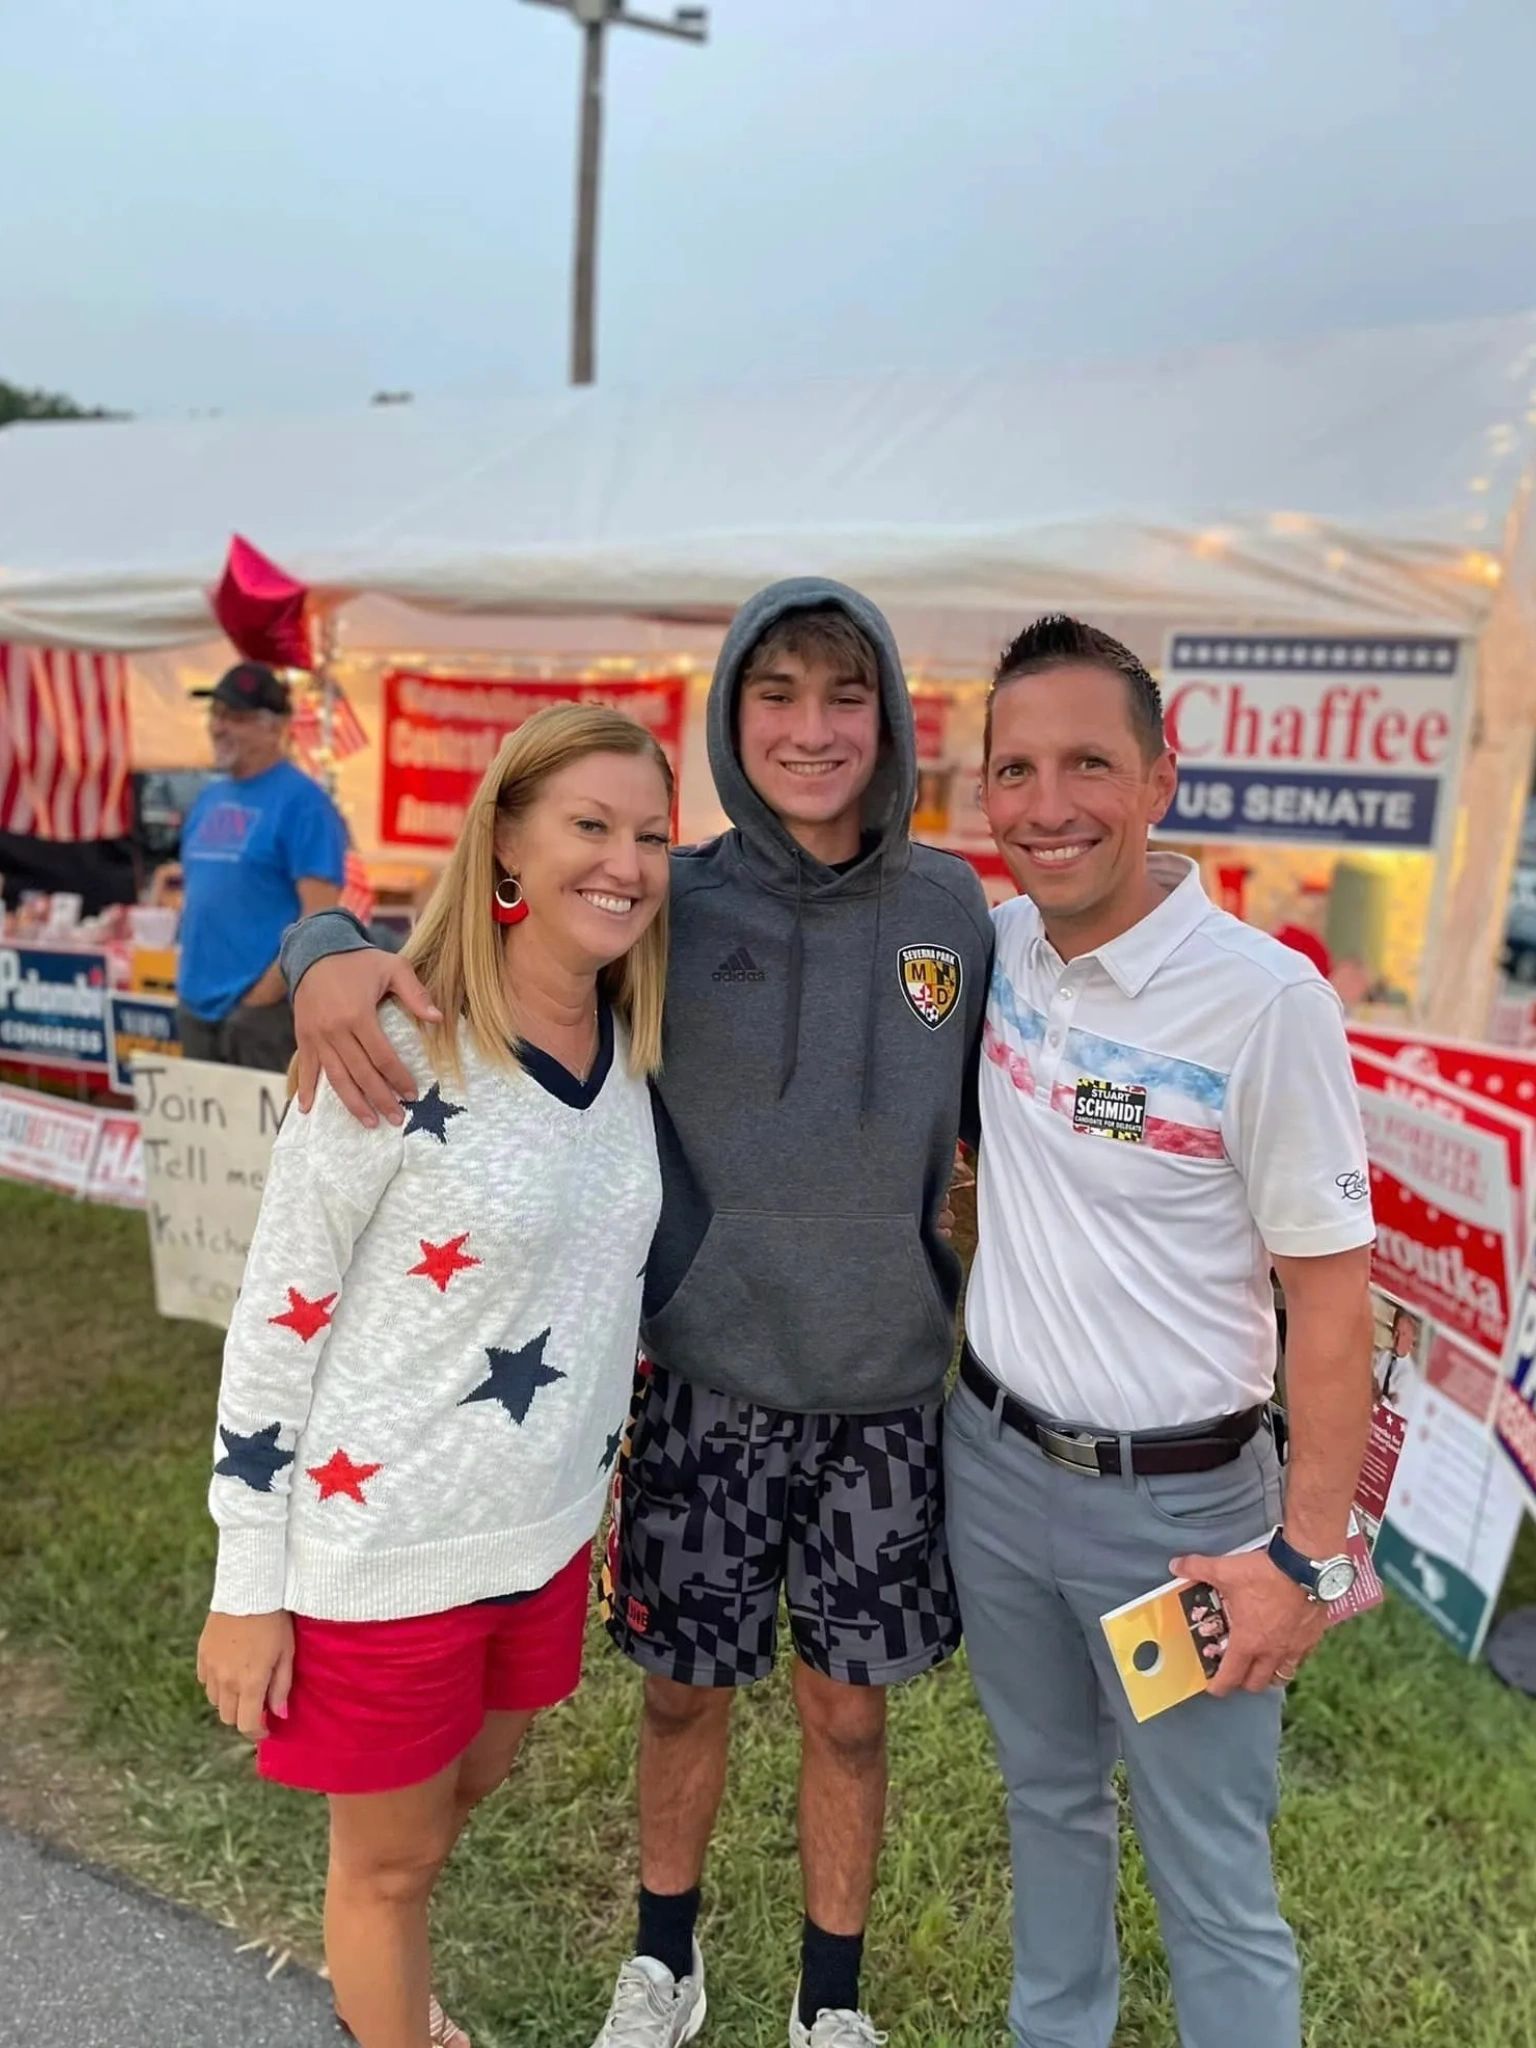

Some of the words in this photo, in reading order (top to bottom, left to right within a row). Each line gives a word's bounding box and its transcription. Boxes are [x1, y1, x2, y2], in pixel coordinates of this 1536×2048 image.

[1164, 679, 1451, 765] Chaffee
[1175, 781, 1234, 819] US
[1242, 784, 1416, 829] SENATE
[902, 949, 935, 961] SEVERNA
[936, 951, 955, 964] PARK
[711, 969, 767, 982] adidas
[133, 1068, 227, 1129] Join
[1092, 1089, 1131, 1102] STUART
[1076, 1097, 1143, 1123] SCHMIDT
[1075, 1115, 1102, 1126] CANDIDATE
[1116, 1121, 1142, 1132] DELEGATE
[144, 1138, 207, 1184] Tell
